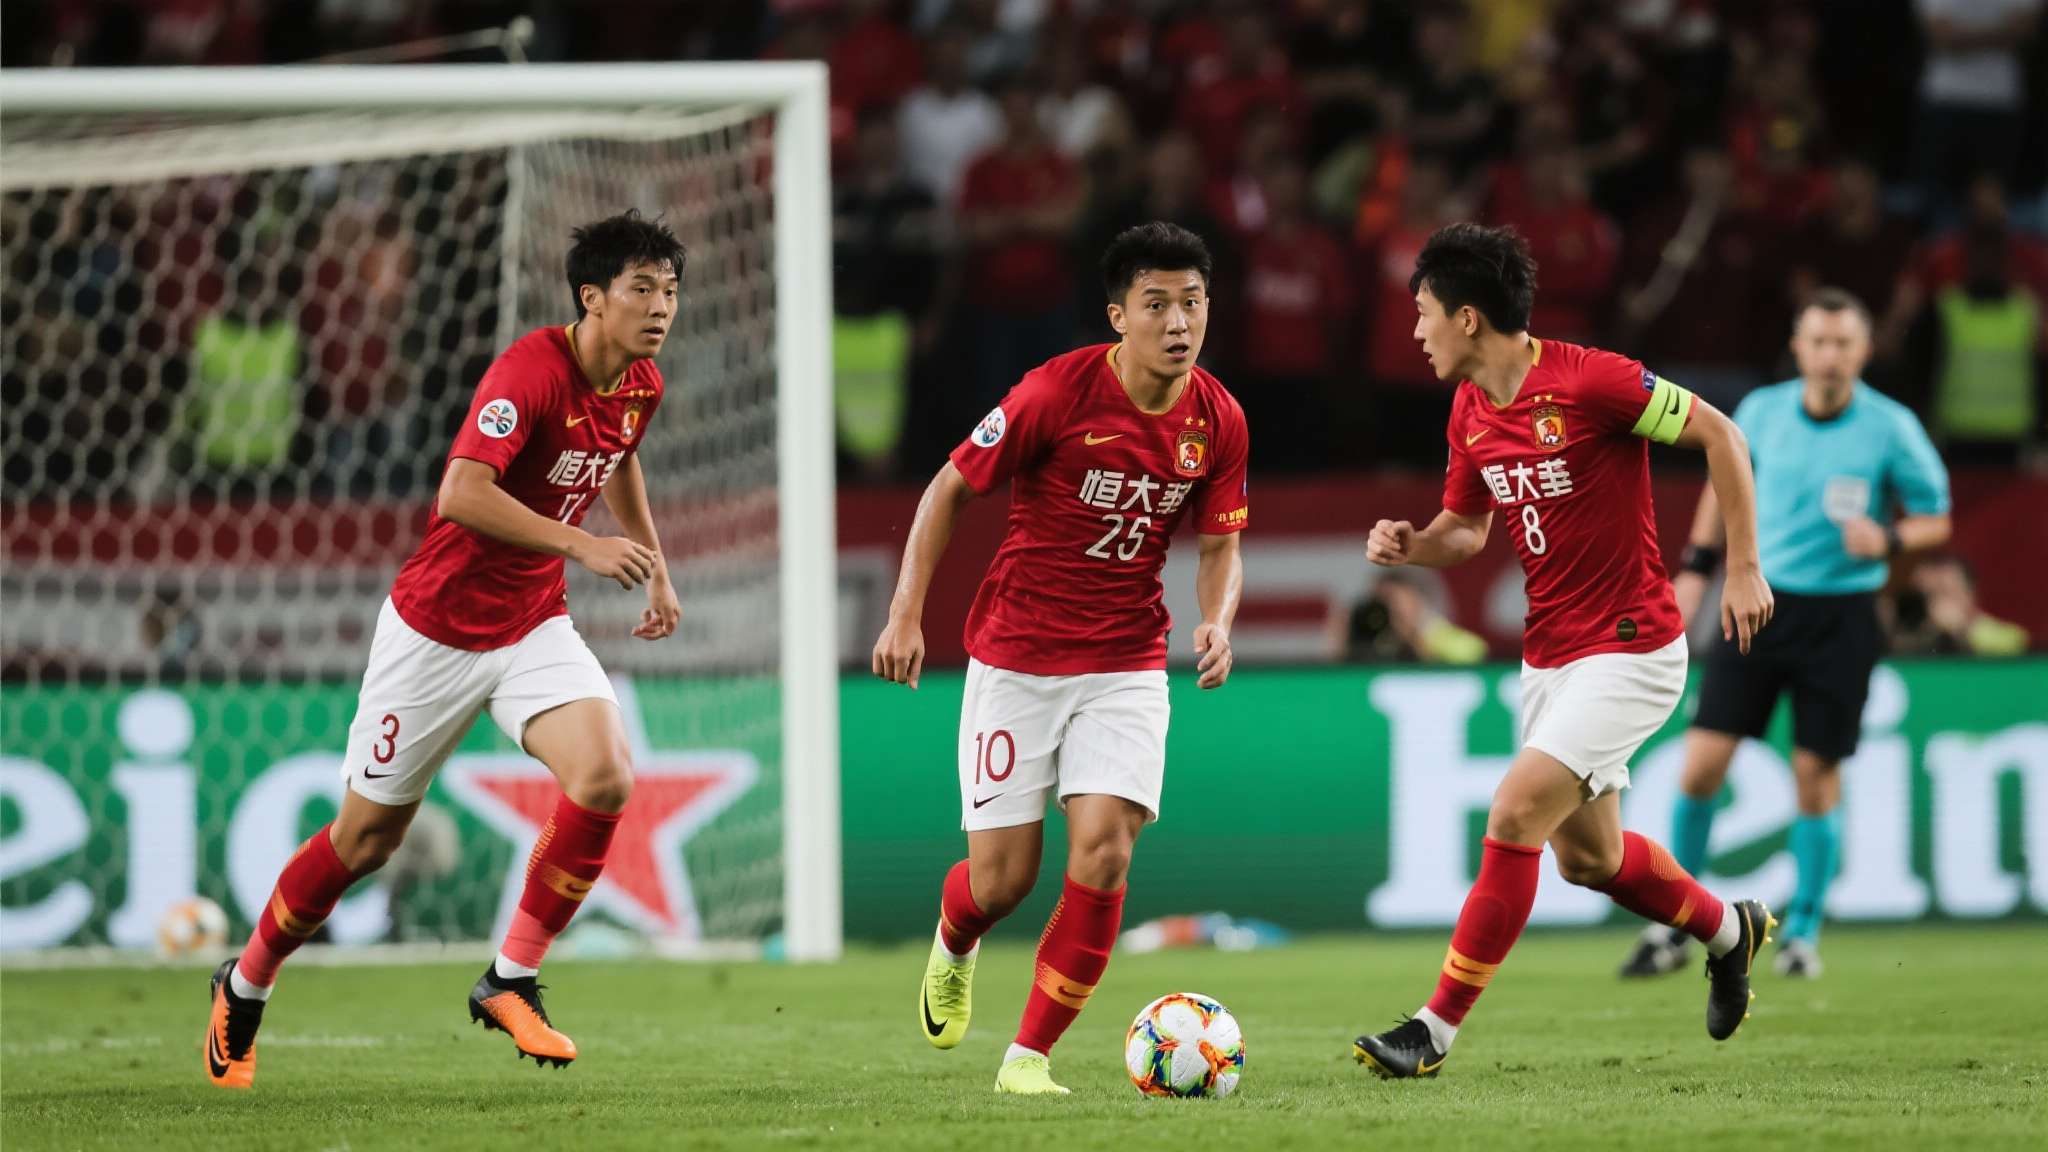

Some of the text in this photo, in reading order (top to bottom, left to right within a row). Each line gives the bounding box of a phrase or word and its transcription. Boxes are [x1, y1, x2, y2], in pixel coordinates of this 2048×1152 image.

[1085, 513, 1151, 561] 25
[1521, 504, 1546, 555] 8
[373, 713, 400, 764] 3
[975, 729, 1015, 785] 10
